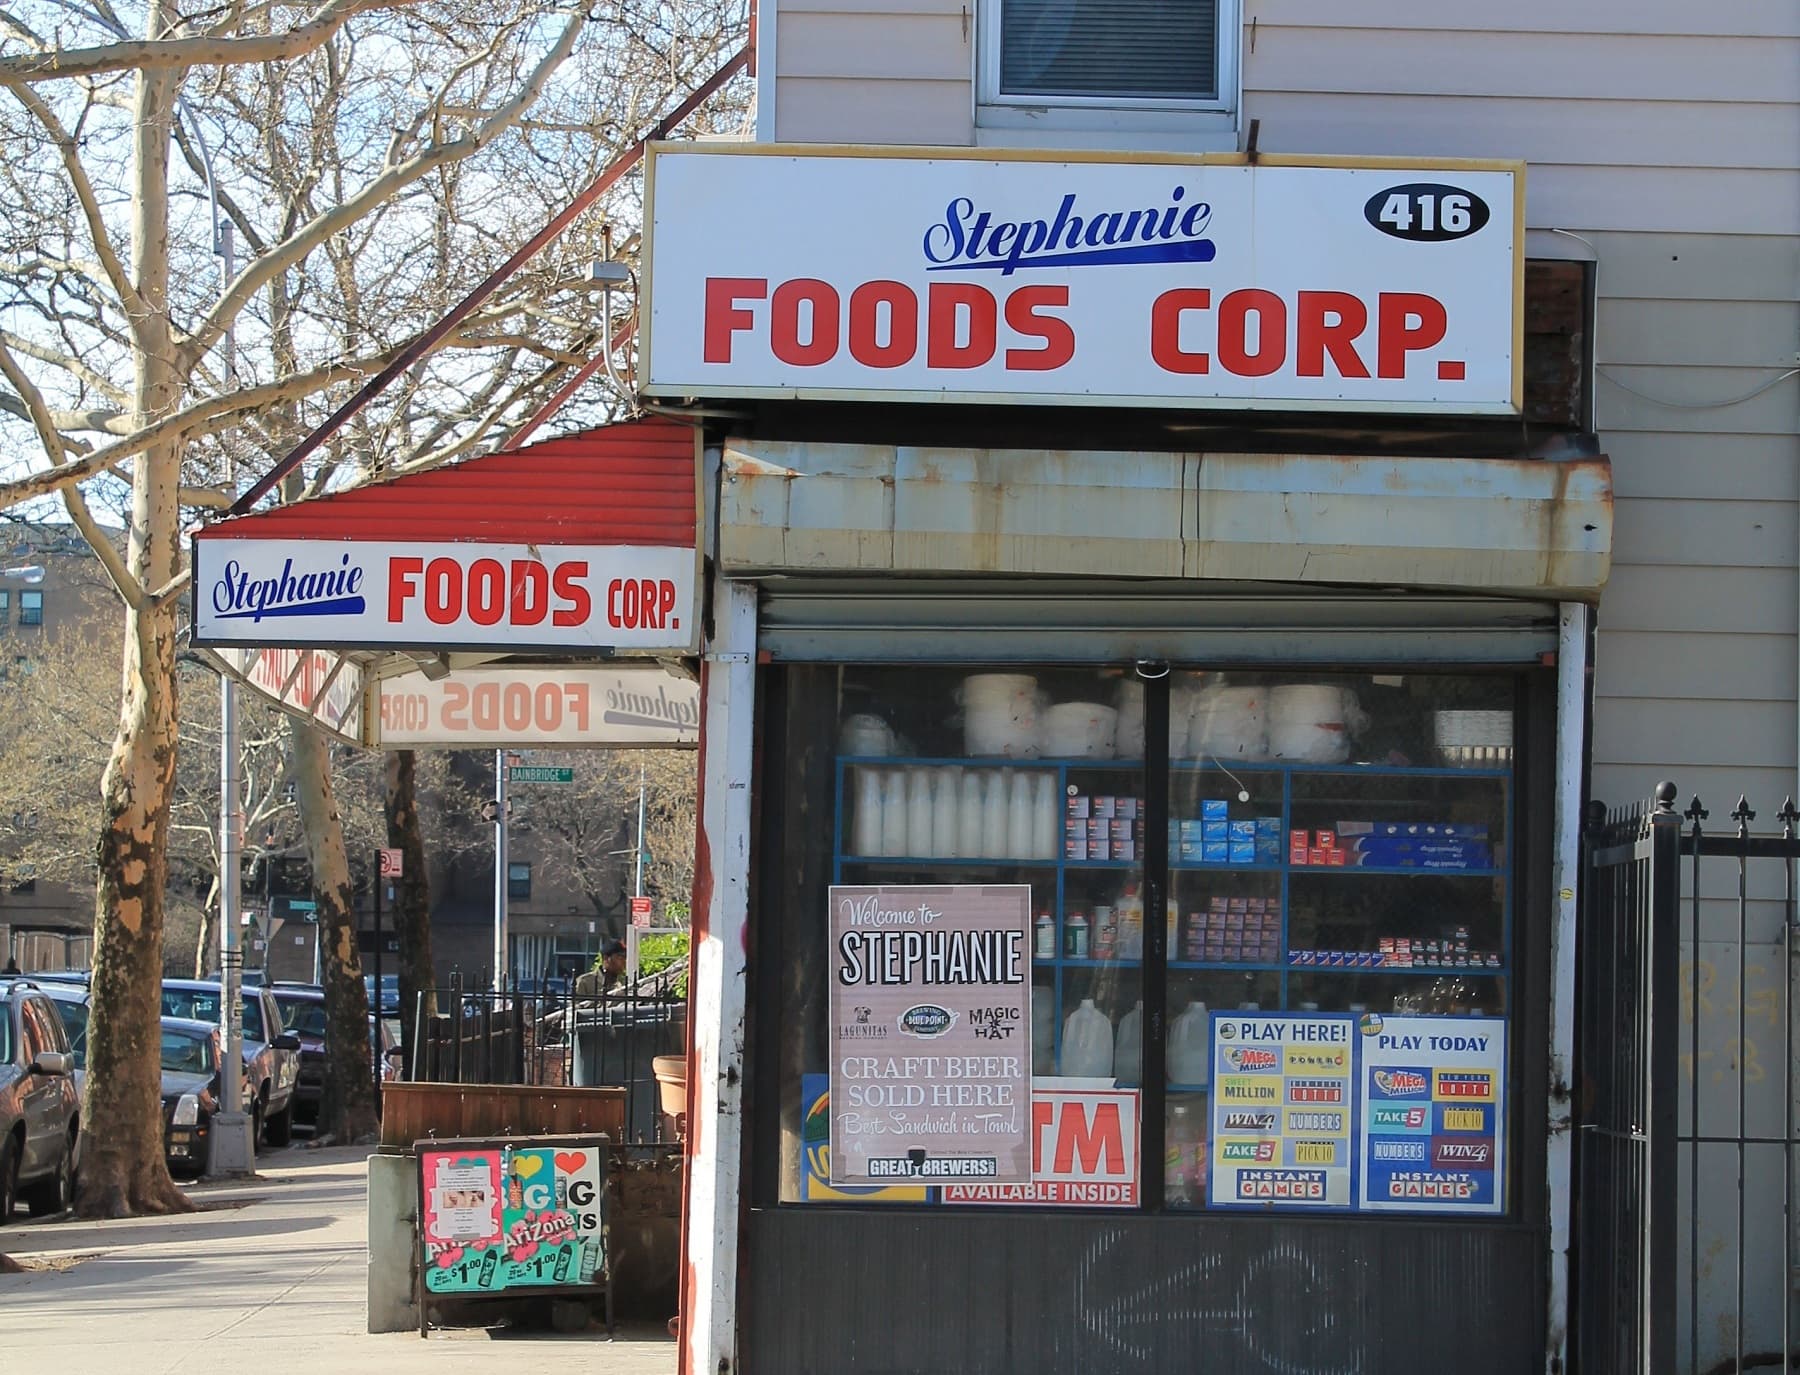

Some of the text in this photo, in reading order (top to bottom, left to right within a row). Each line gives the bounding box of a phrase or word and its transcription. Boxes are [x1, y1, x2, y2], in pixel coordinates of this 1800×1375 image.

[1379, 194, 1472, 233] 416
[923, 186, 1214, 275] Stephanie
[703, 277, 1466, 381] FOODS CORP.
[213, 553, 680, 630] Stephanie FOODS CORP.
[511, 768, 560, 780] BAINBRIDGE
[840, 896, 943, 928] Welcome to
[839, 930, 1024, 985] STEPHANIE
[969, 1007, 1020, 1025] MAGIC
[839, 1025, 888, 1036] LAGUNITAS
[975, 1027, 1015, 1040] HAT
[1241, 1023, 1285, 1041] PLAY
[1292, 1024, 1346, 1042] HERE!
[1379, 1035, 1489, 1052] PLAY TODAY
[1241, 1050, 1277, 1063] MEGA
[841, 1056, 1022, 1080] CRAFT BEER
[1391, 1073, 1425, 1088] MEGA
[848, 1084, 1015, 1107] SOLD HERE
[1225, 1086, 1275, 1099] MILLION
[1291, 1089, 1340, 1101] LOTTO
[1440, 1084, 1489, 1095] LOTTO
[836, 1106, 1020, 1135] Best Sandwich in Town
[1289, 1112, 1341, 1130] NUMBERS
[1376, 1110, 1422, 1124] TAKE 5
[1224, 1144, 1272, 1158] TAKE 5
[1298, 1145, 1319, 1160] PICK
[1374, 1142, 1424, 1160] NUMBERS
[870, 1160, 914, 1176] GREAT
[922, 1159, 988, 1176] BREWERS
[1242, 1171, 1322, 1181] INSTANT
[1391, 1172, 1470, 1182] INSTANT
[950, 1184, 1131, 1202] AVAILABLE INSIDE
[1242, 1183, 1321, 1195] GAMES
[1392, 1183, 1469, 1196] GAMES
[504, 1214, 576, 1252] AriZona
[451, 1258, 481, 1284] $1.00
[526, 1253, 556, 1277] $1.00
